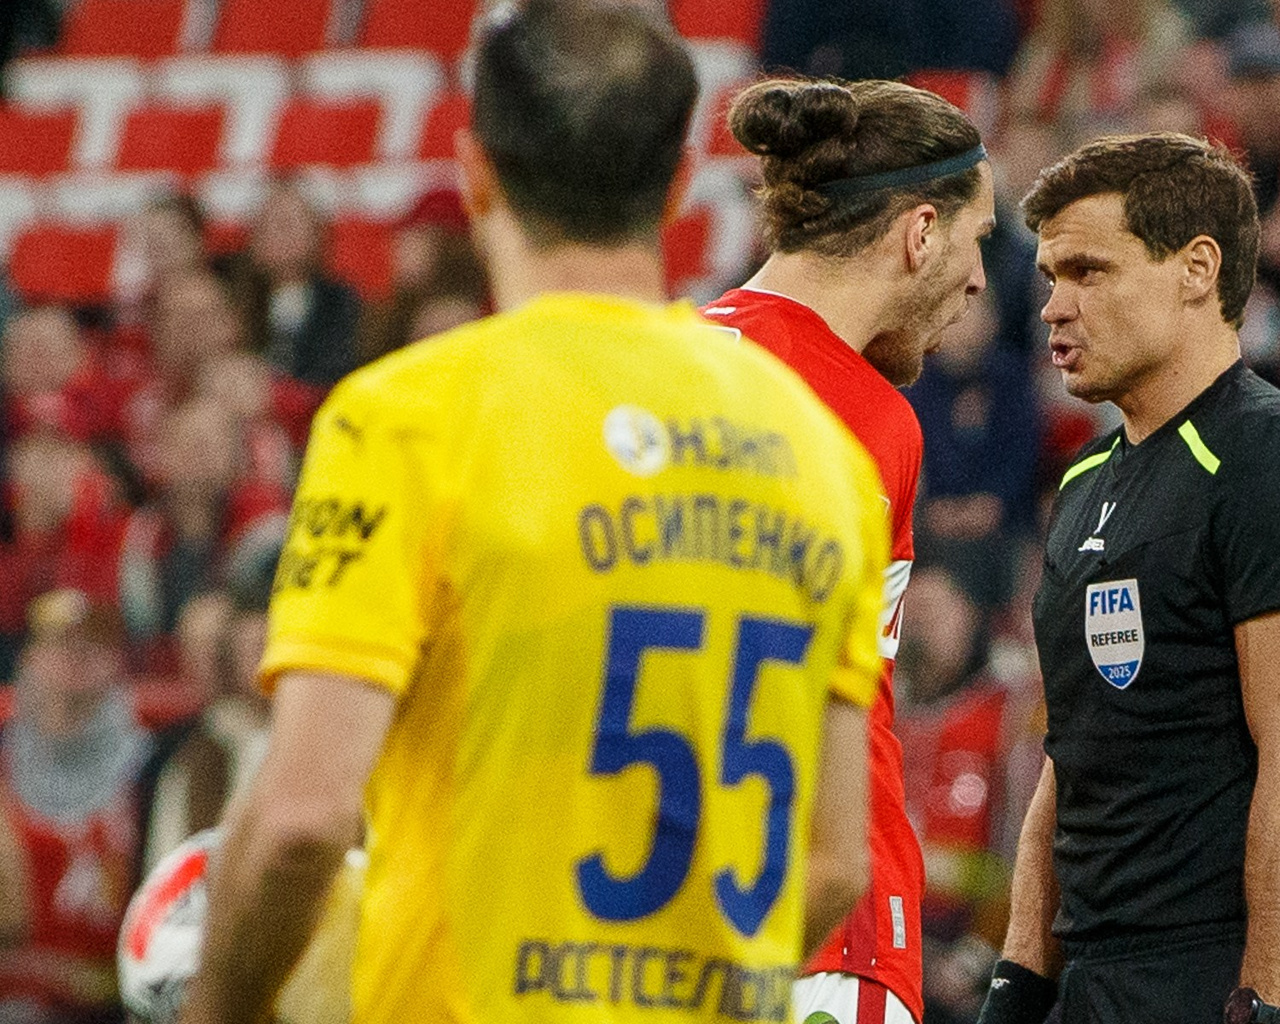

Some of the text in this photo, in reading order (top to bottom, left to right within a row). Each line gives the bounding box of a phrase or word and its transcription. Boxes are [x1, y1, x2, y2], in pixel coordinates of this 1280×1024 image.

[578, 494, 843, 602] ОСИПЕНКО
[1090, 587, 1134, 616] FIFA
[1091, 629, 1139, 647] REFEREE
[1108, 665, 1131, 680] 2025
[574, 604, 815, 939] 55
